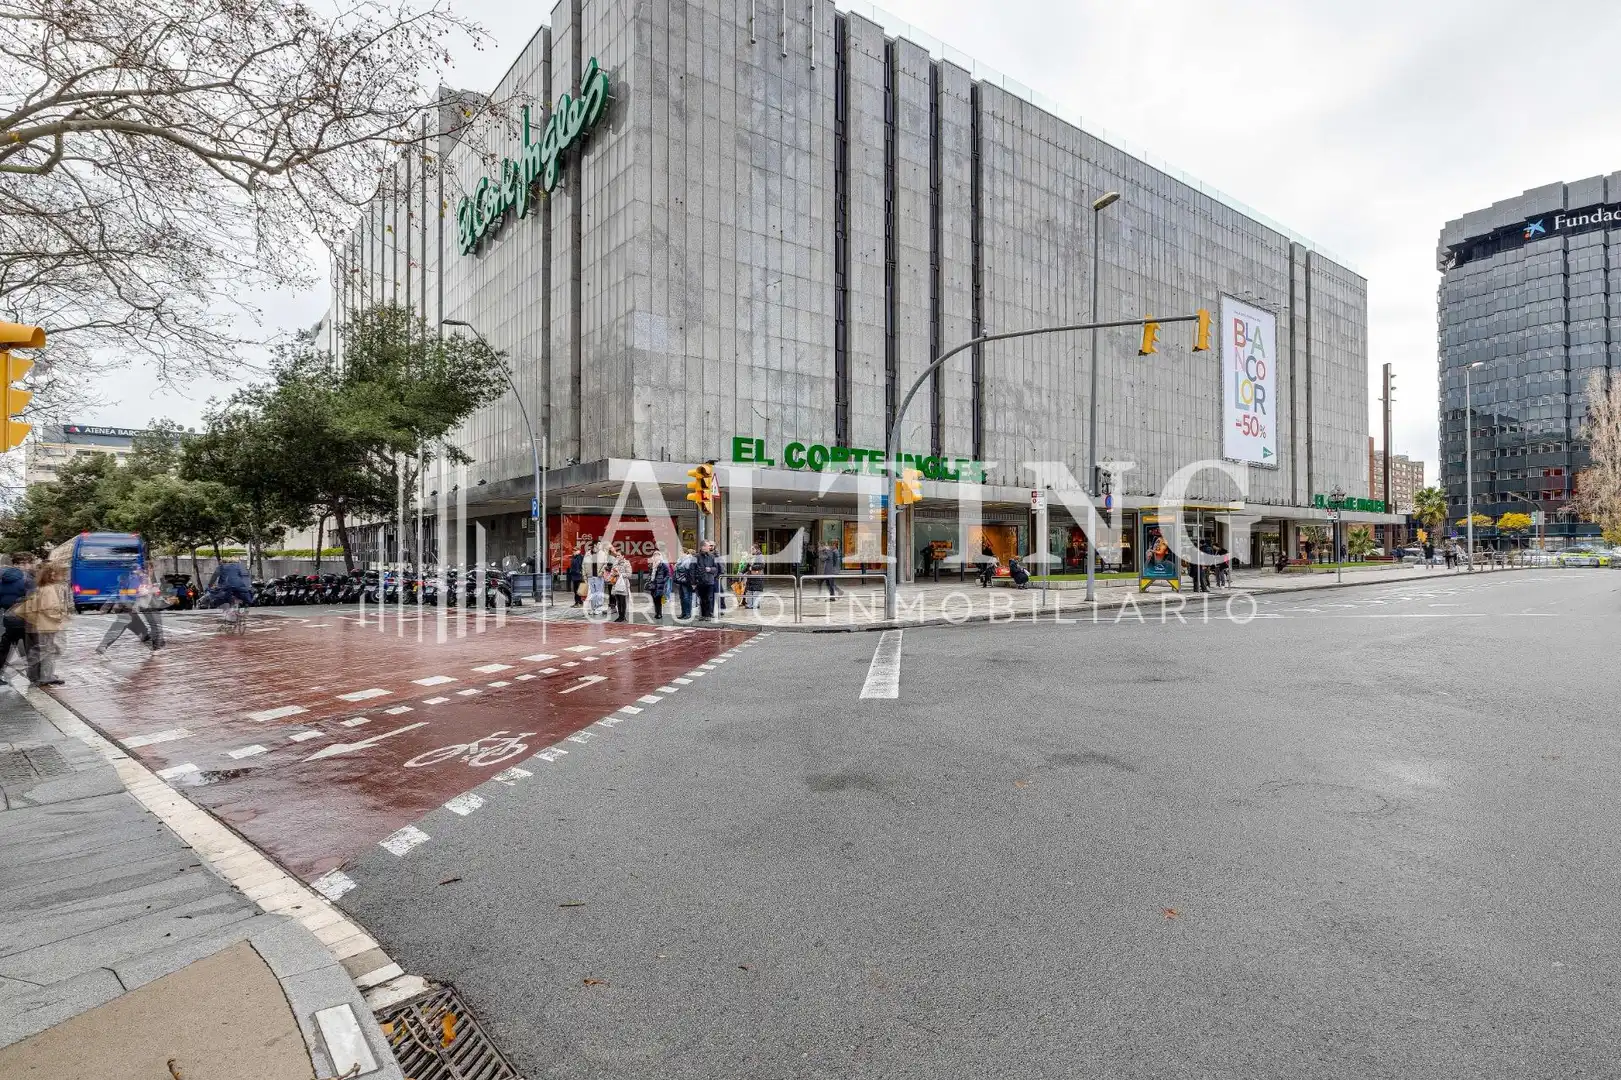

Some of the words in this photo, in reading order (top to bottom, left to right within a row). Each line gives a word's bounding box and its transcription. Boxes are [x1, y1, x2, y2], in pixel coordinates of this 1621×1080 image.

[84, 426, 116, 436] ATENEA
[732, 437, 774, 466] EL
[784, 441, 886, 475] CORTE
[896, 452, 988, 485] INGLES
[576, 531, 594, 541] Les
[577, 536, 668, 556] reaixes
